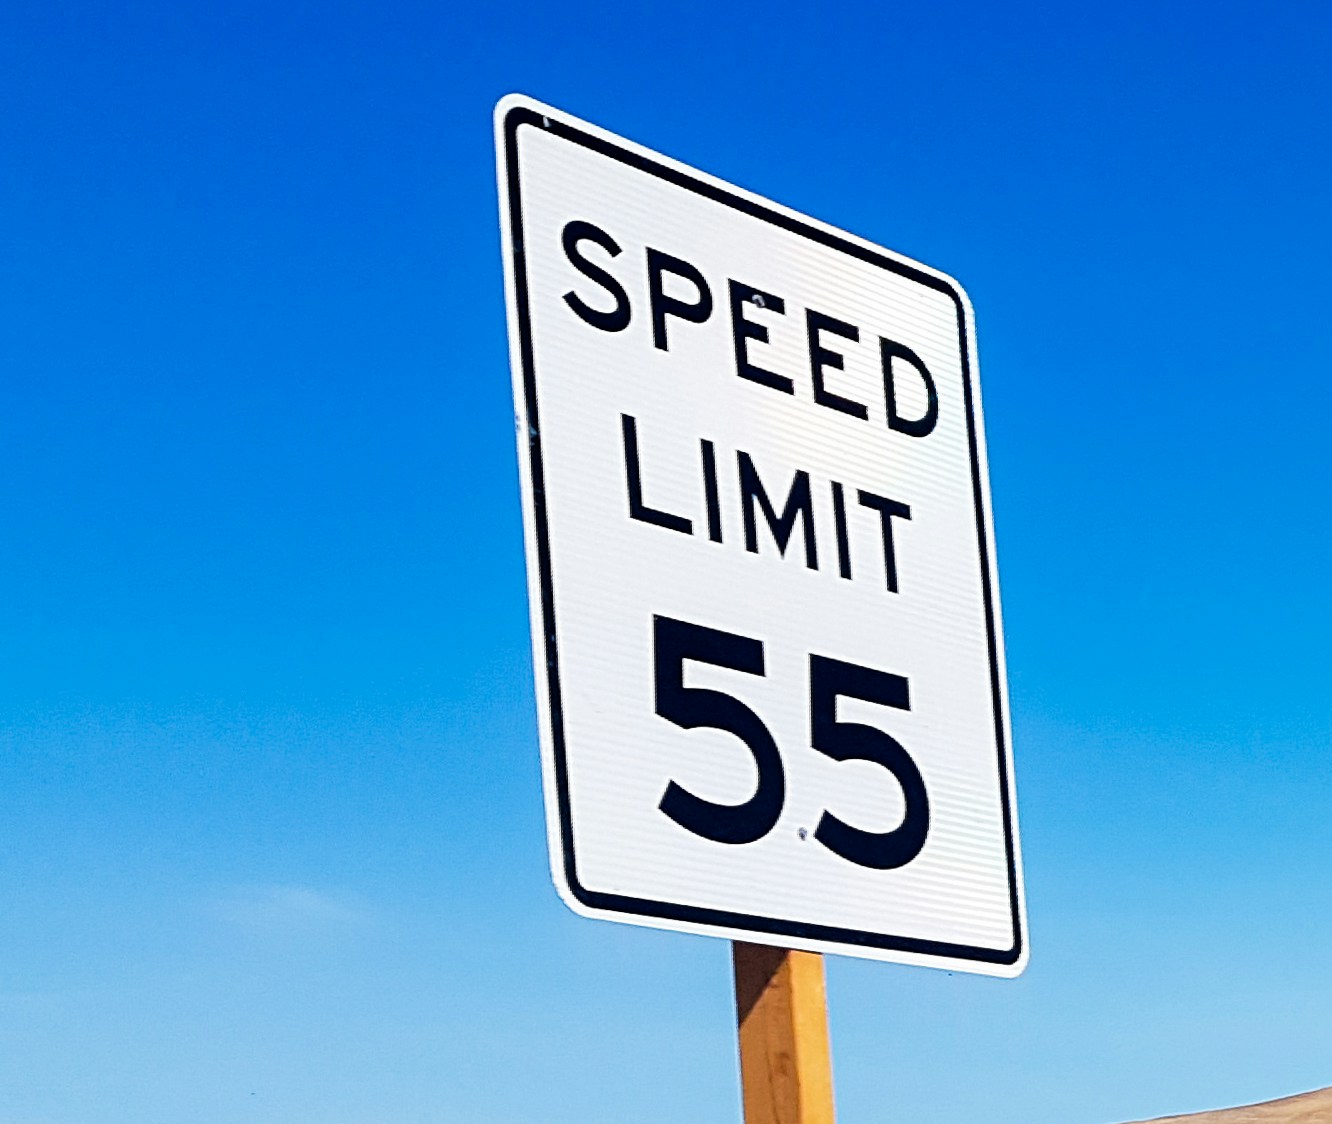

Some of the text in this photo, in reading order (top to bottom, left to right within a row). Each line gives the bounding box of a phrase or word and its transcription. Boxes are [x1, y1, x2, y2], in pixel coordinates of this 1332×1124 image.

[562, 221, 938, 437] SPEED
[621, 413, 912, 593] LIMIT
[653, 614, 929, 870] 55
